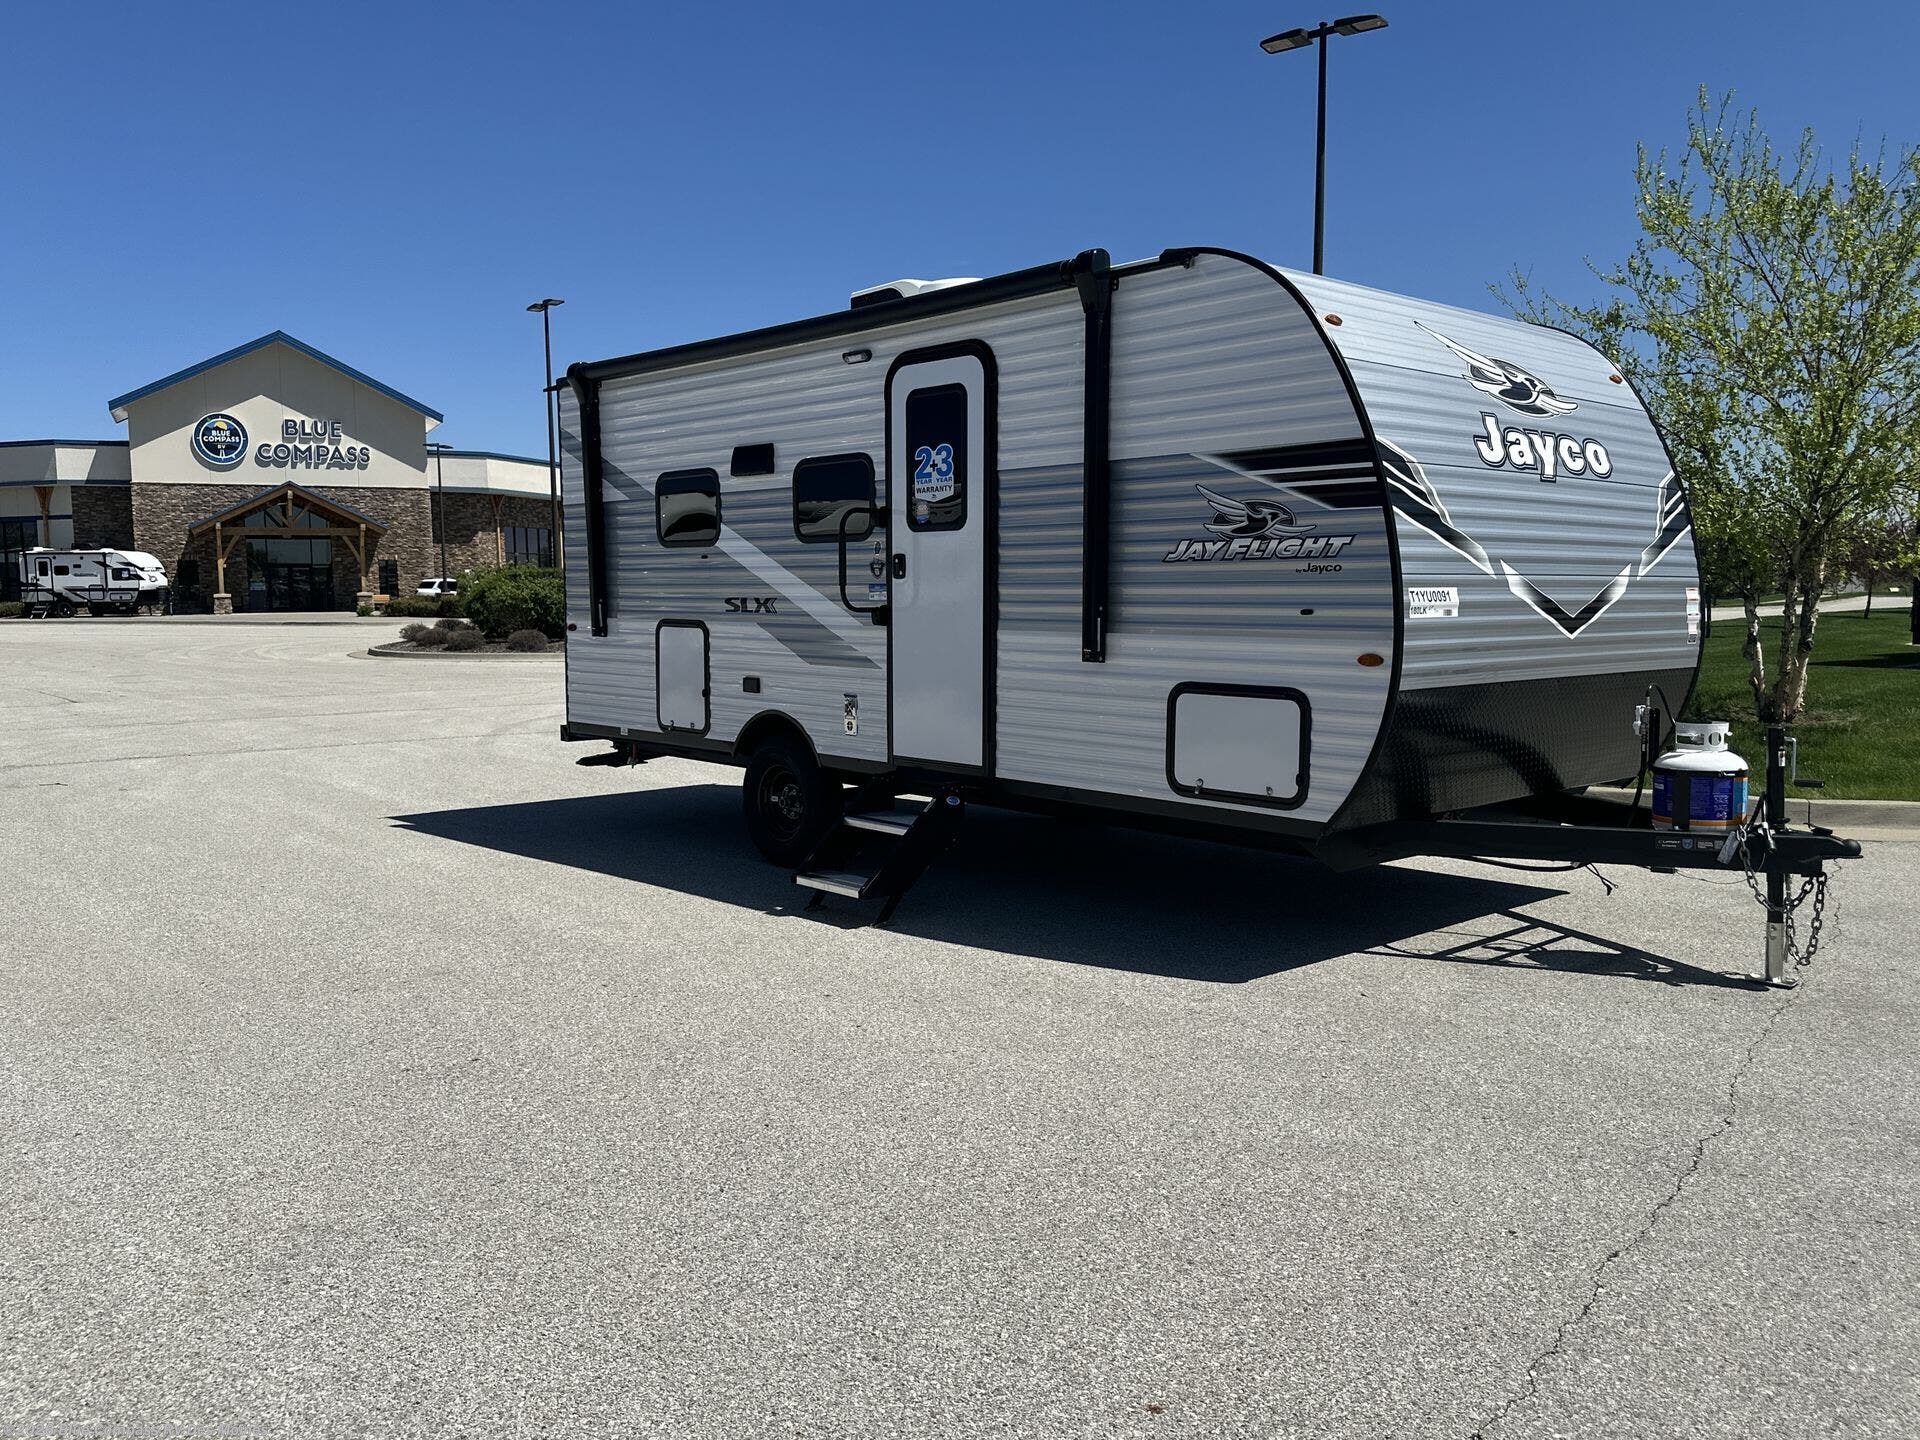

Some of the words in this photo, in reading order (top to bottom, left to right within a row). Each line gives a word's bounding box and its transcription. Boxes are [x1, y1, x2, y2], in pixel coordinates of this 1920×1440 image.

[283, 418, 342, 439] BLUE
[256, 443, 371, 464] COMPASS
[1473, 411, 1614, 483] Jayco
[916, 485, 952, 493] WARRANTY
[1223, 534, 1358, 562] FLIGHT
[1303, 563, 1343, 575] Jayco
[724, 597, 778, 615] SLX
[1410, 591, 1451, 602] T1YU0091
